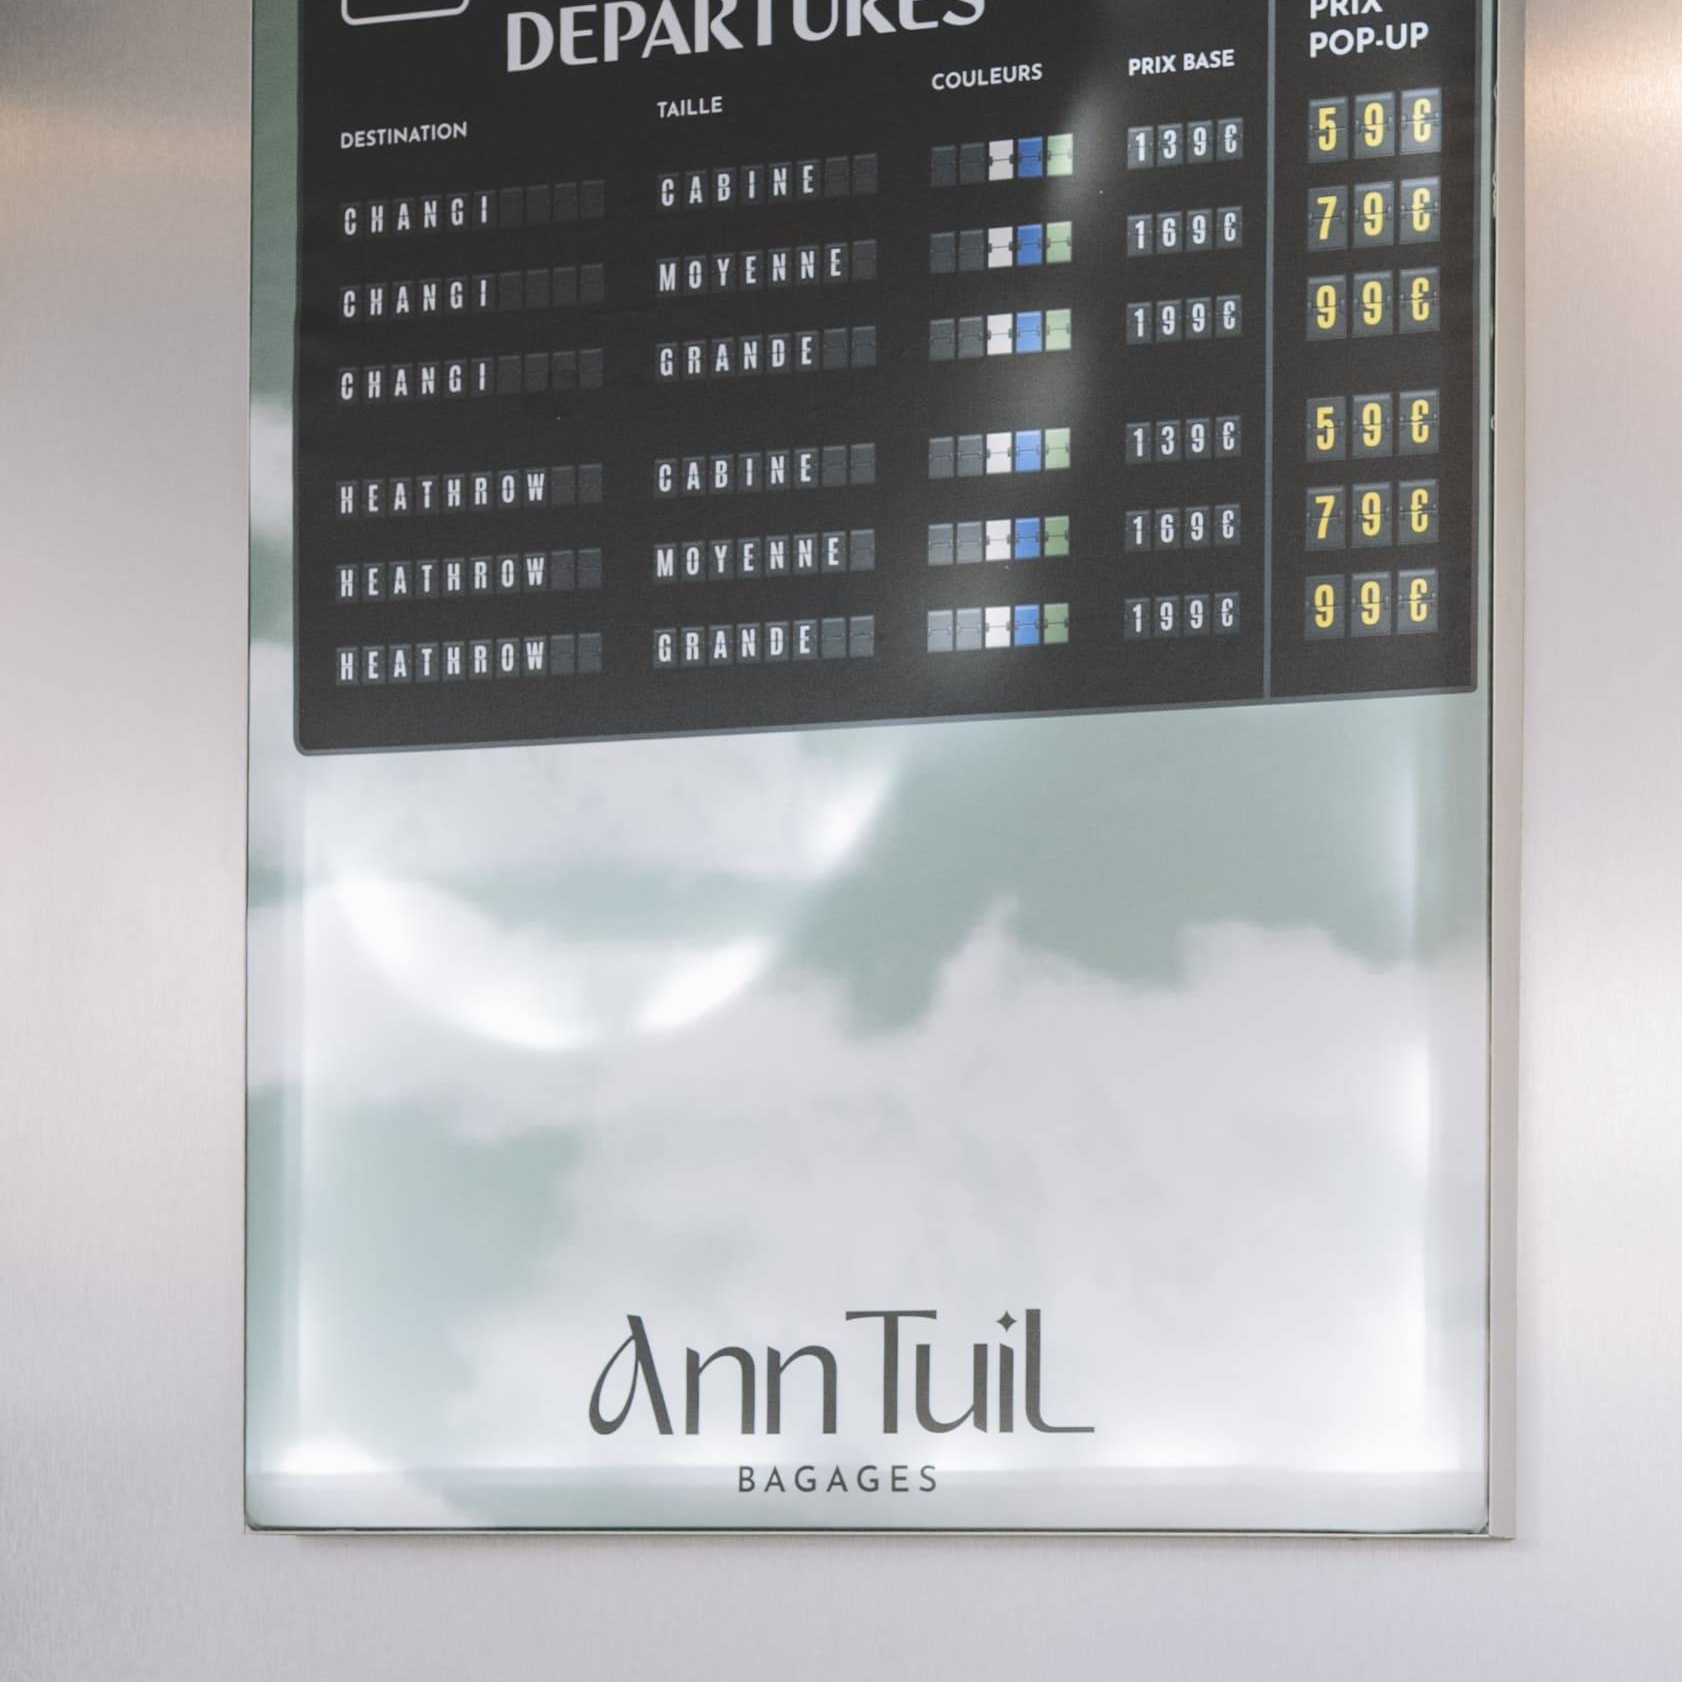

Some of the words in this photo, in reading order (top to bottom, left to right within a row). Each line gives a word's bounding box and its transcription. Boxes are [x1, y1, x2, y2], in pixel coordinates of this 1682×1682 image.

[1308, 20, 1430, 59] POP-UP
[930, 62, 1044, 92] COULEURS
[1128, 54, 1177, 77] PRIX
[1183, 48, 1236, 72] BASE
[656, 94, 724, 119] TAILLE
[339, 120, 469, 150] DESTINATION
[660, 163, 815, 208] CABINE
[344, 195, 489, 236] CHANGI
[658, 247, 842, 293] MOYENNE
[343, 279, 488, 319] CHANGI
[658, 335, 813, 378] GRANDE
[339, 362, 487, 401] CHANGI
[657, 452, 812, 493] CABINE
[339, 471, 546, 515] HEATHROW
[339, 555, 546, 598] HEATHROW
[656, 535, 840, 578] MOYENNE
[339, 639, 546, 681] HEATHROW
[656, 624, 812, 664] GRANDE
[737, 1463, 938, 1494] BAGAGES
